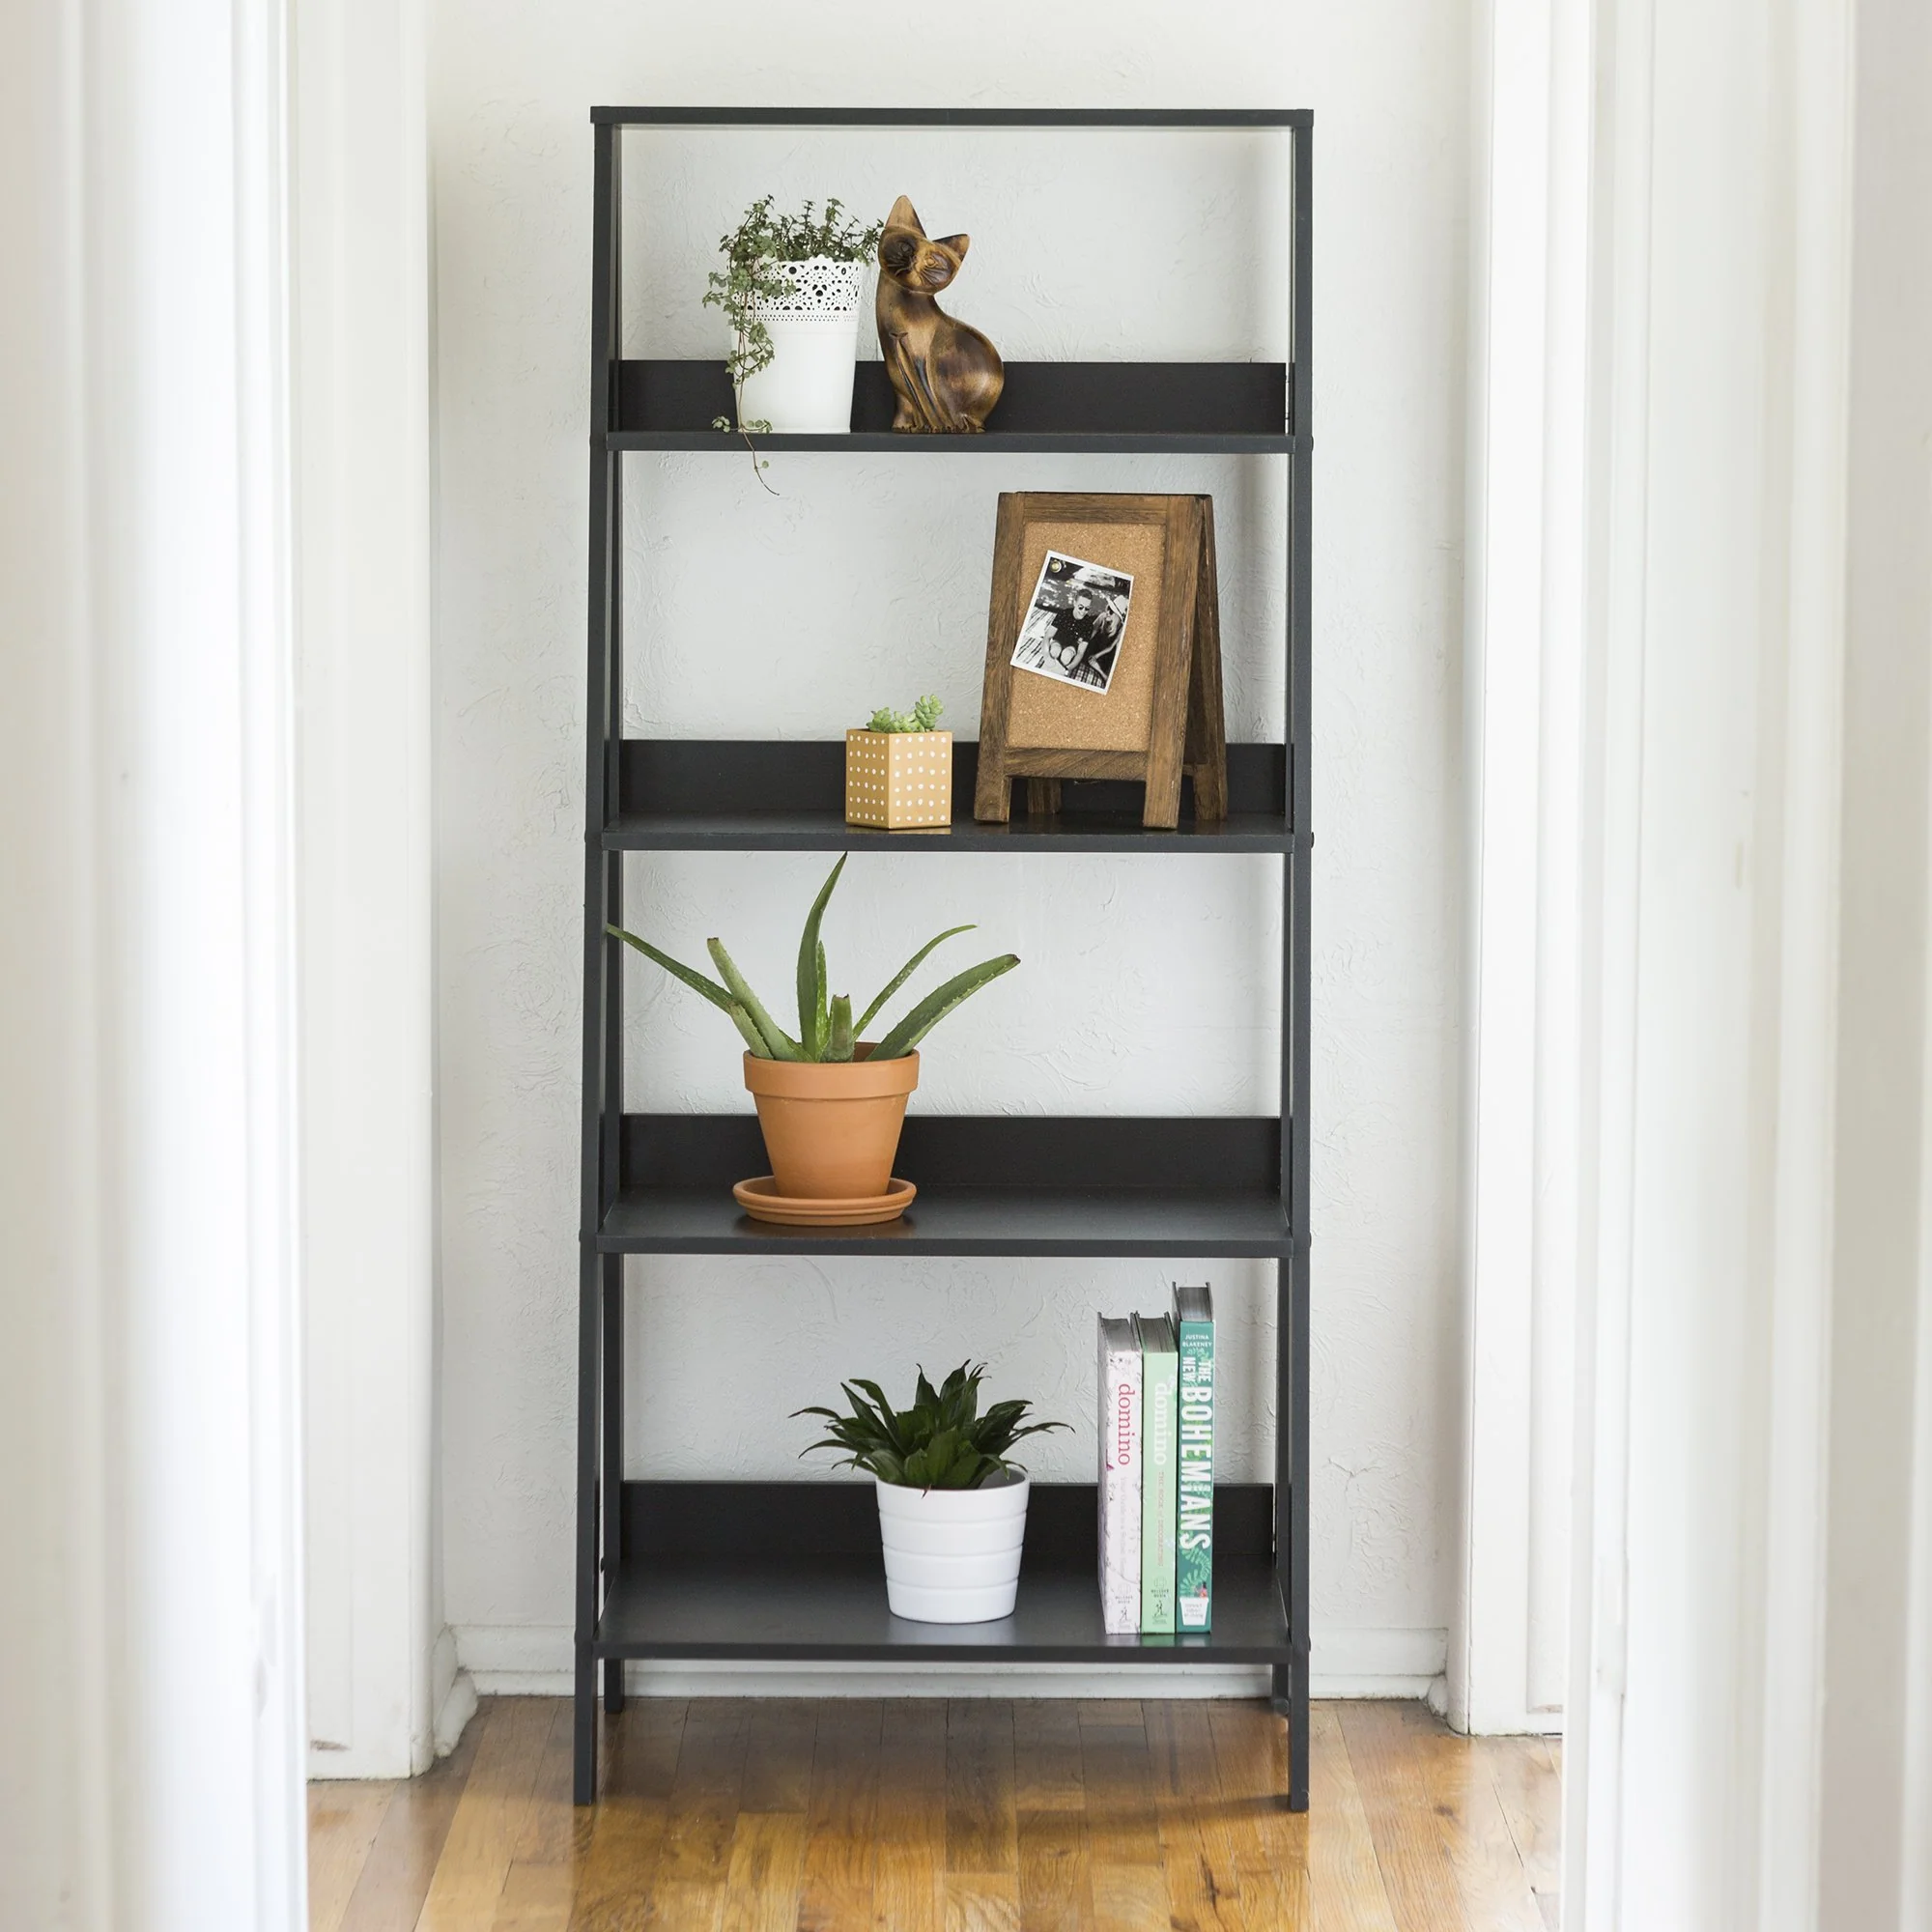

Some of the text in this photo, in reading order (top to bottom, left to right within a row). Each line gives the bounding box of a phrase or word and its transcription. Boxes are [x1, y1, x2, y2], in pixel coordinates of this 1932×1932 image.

[1182, 1356, 1197, 1382] NEW
[1198, 1359, 1212, 1382] THE
[1118, 1383, 1135, 1465] domino
[1154, 1382, 1172, 1465] domino
[1180, 1386, 1212, 1549] BOHEMIANS
